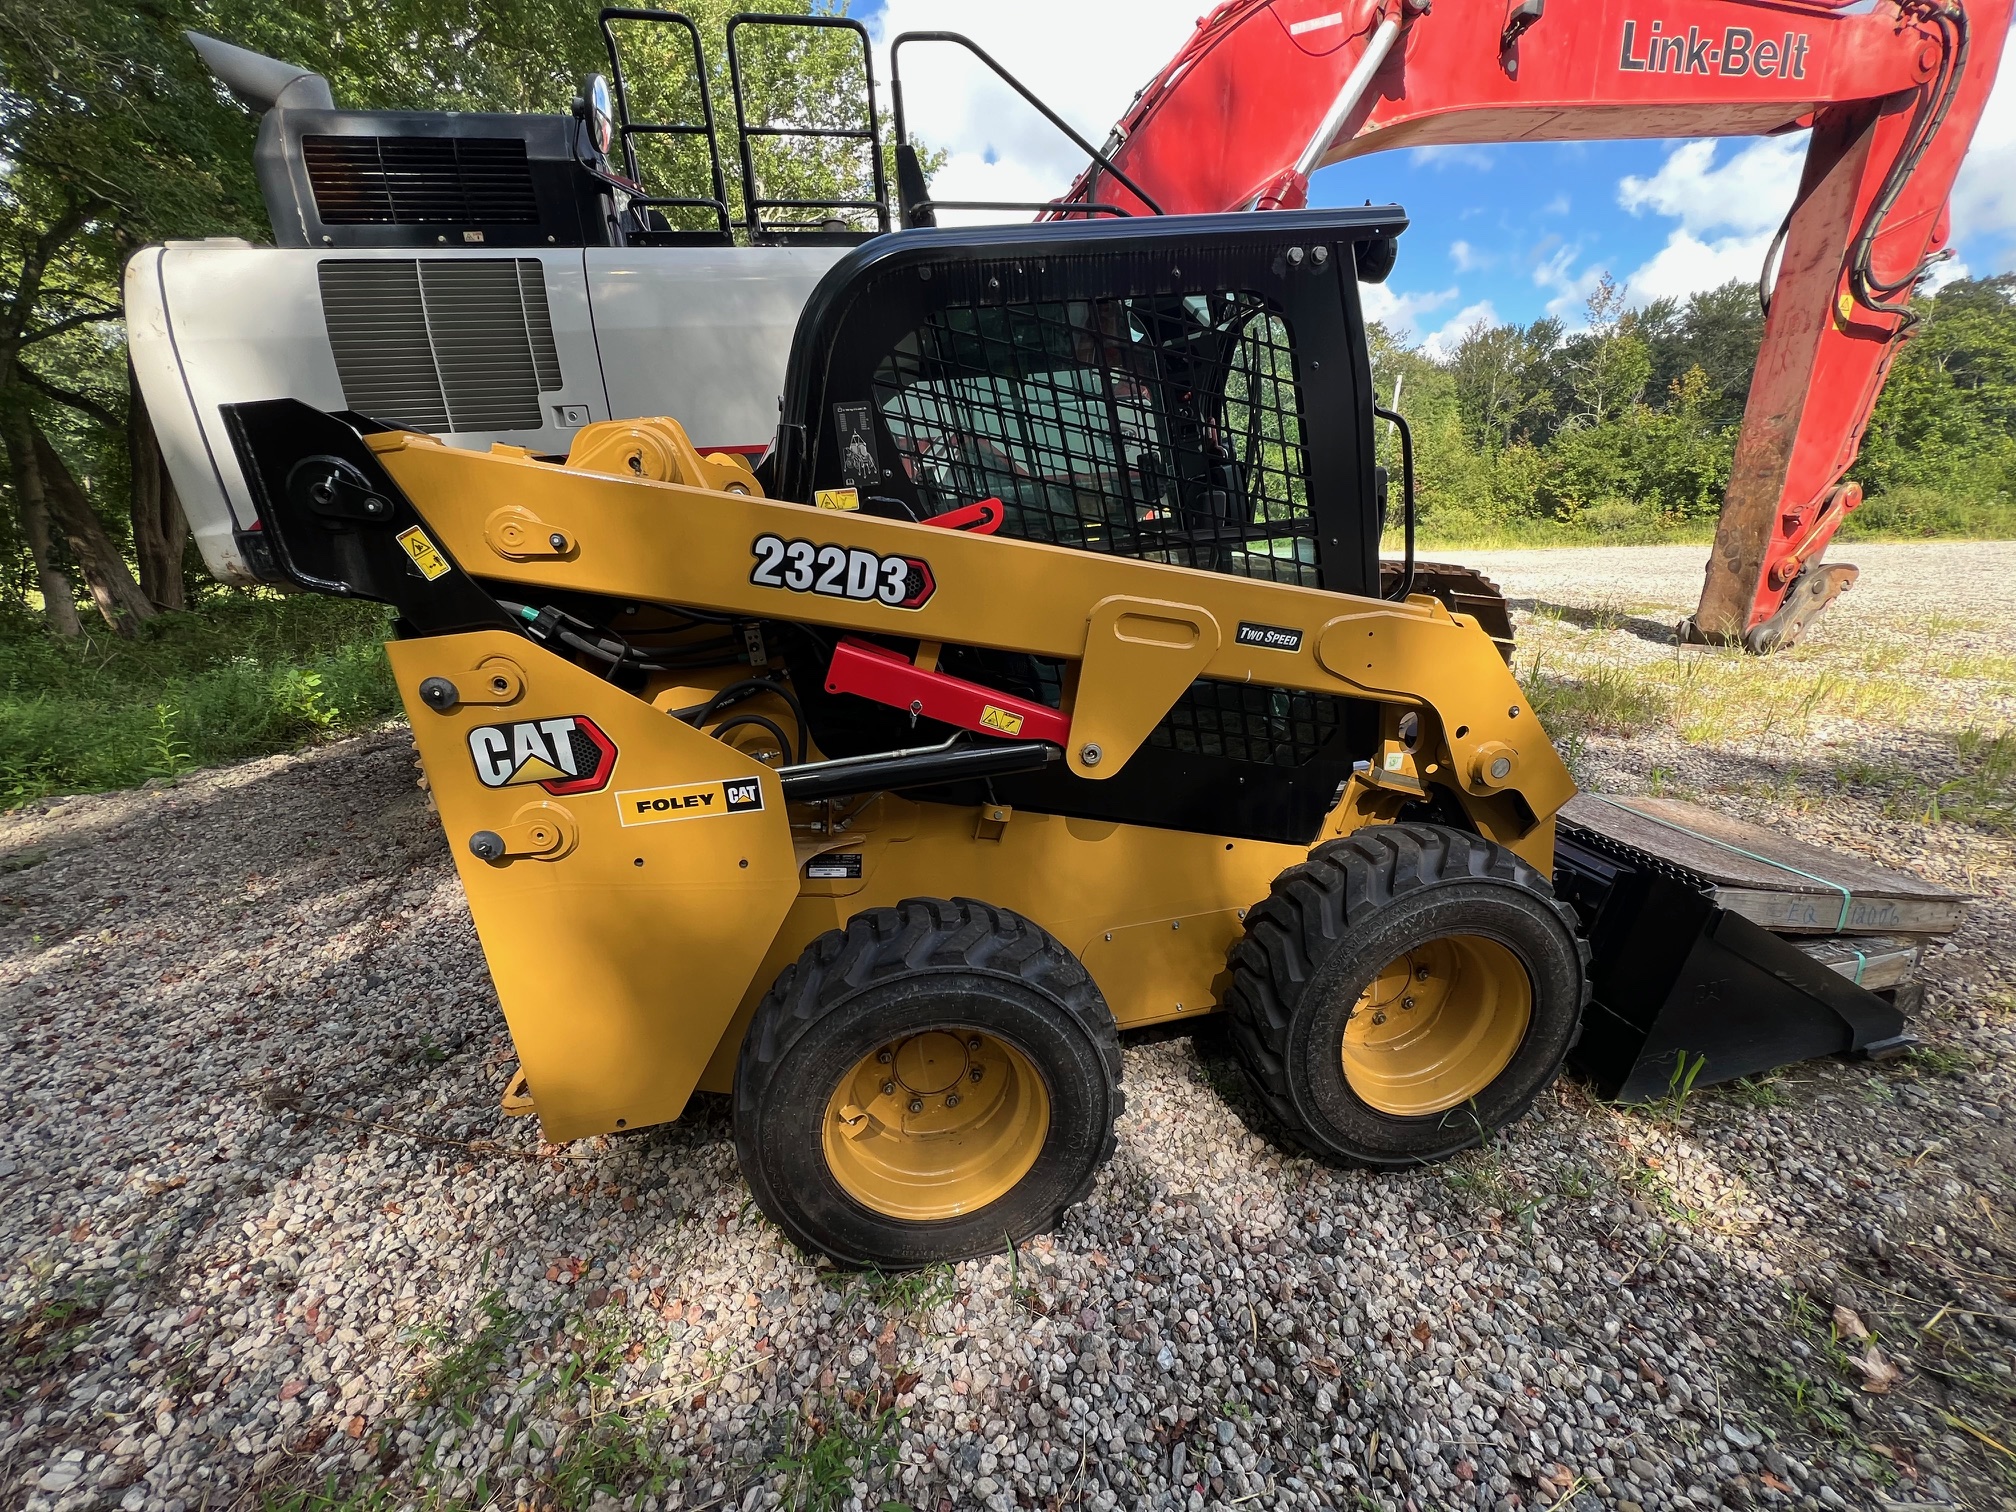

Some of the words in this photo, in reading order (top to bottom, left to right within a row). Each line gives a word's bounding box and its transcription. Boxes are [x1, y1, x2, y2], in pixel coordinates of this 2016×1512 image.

[1619, 20, 1809, 80] Link-Belt
[753, 536, 908, 604] 232D3
[469, 717, 578, 786] CAT
[636, 793, 714, 814] FOLEY
[727, 785, 757, 804] CAT
